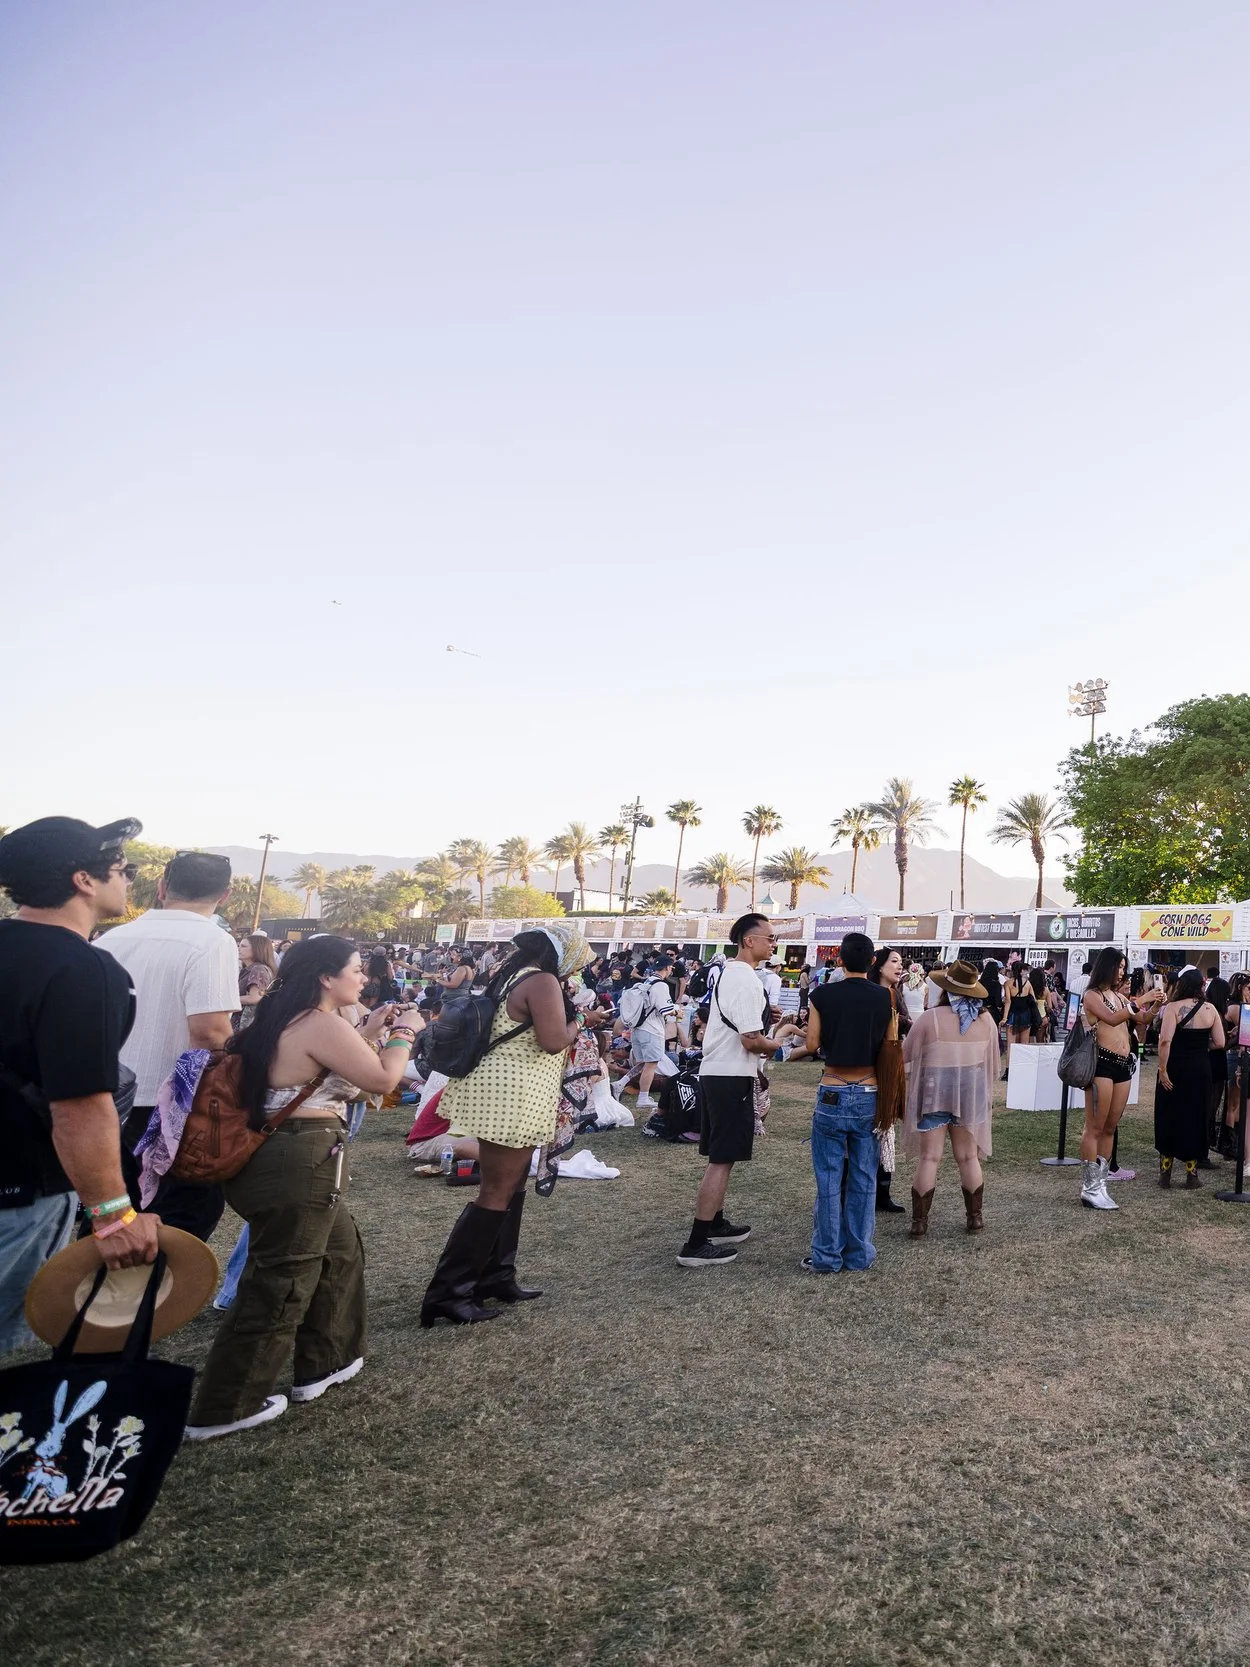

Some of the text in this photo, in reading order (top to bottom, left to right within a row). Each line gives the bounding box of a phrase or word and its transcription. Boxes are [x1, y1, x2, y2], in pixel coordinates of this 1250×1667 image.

[1159, 913, 1212, 925] CORN DOGS
[834, 925, 854, 933] DRAGON
[1161, 926, 1209, 938] GONE WILD
[1029, 951, 1047, 959] ORDER
[1030, 960, 1044, 968] HERE
